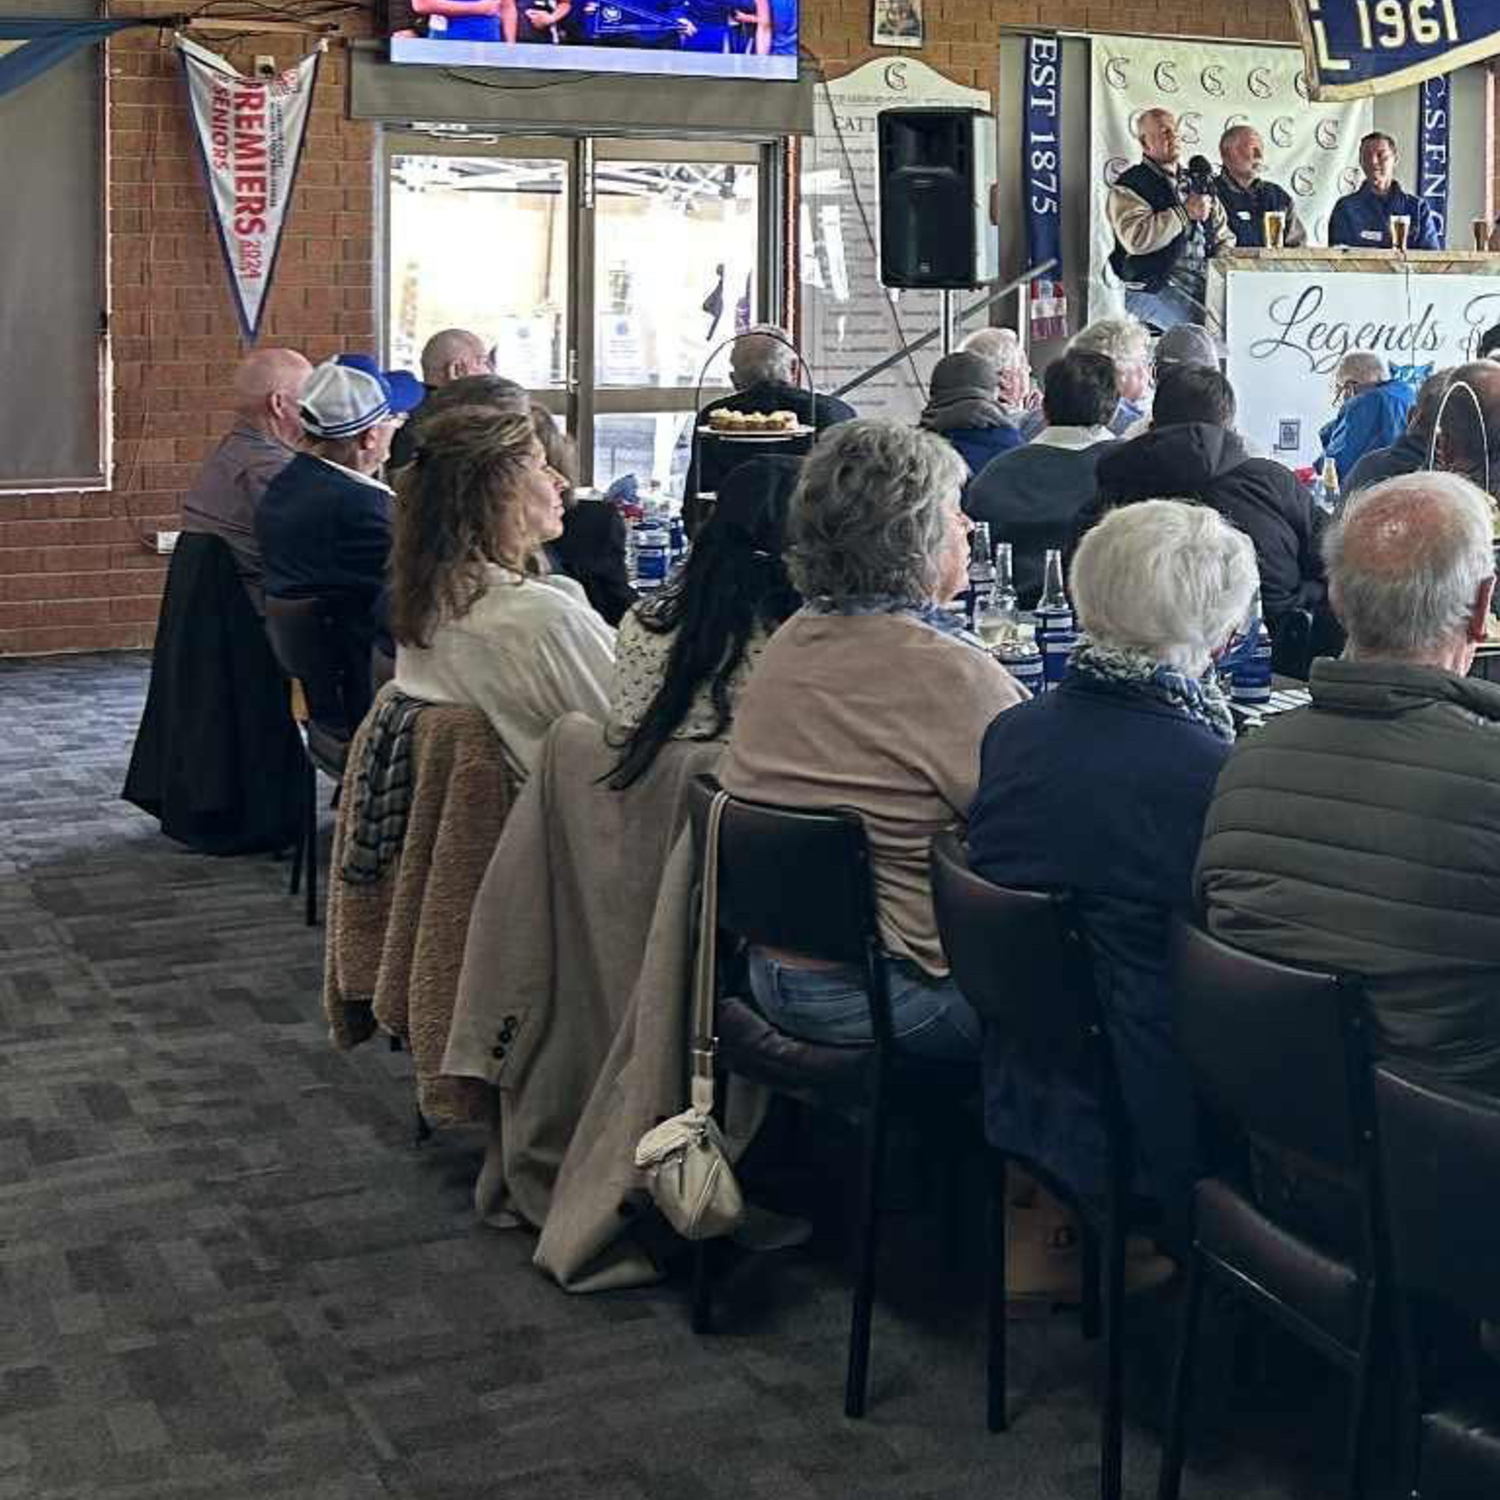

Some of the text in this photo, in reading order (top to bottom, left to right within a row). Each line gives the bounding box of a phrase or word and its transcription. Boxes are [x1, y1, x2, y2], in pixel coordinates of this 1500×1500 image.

[211, 84, 229, 169] SENIORS
[1031, 38, 1058, 214] EST 1875
[1250, 286, 1441, 373] Legends
